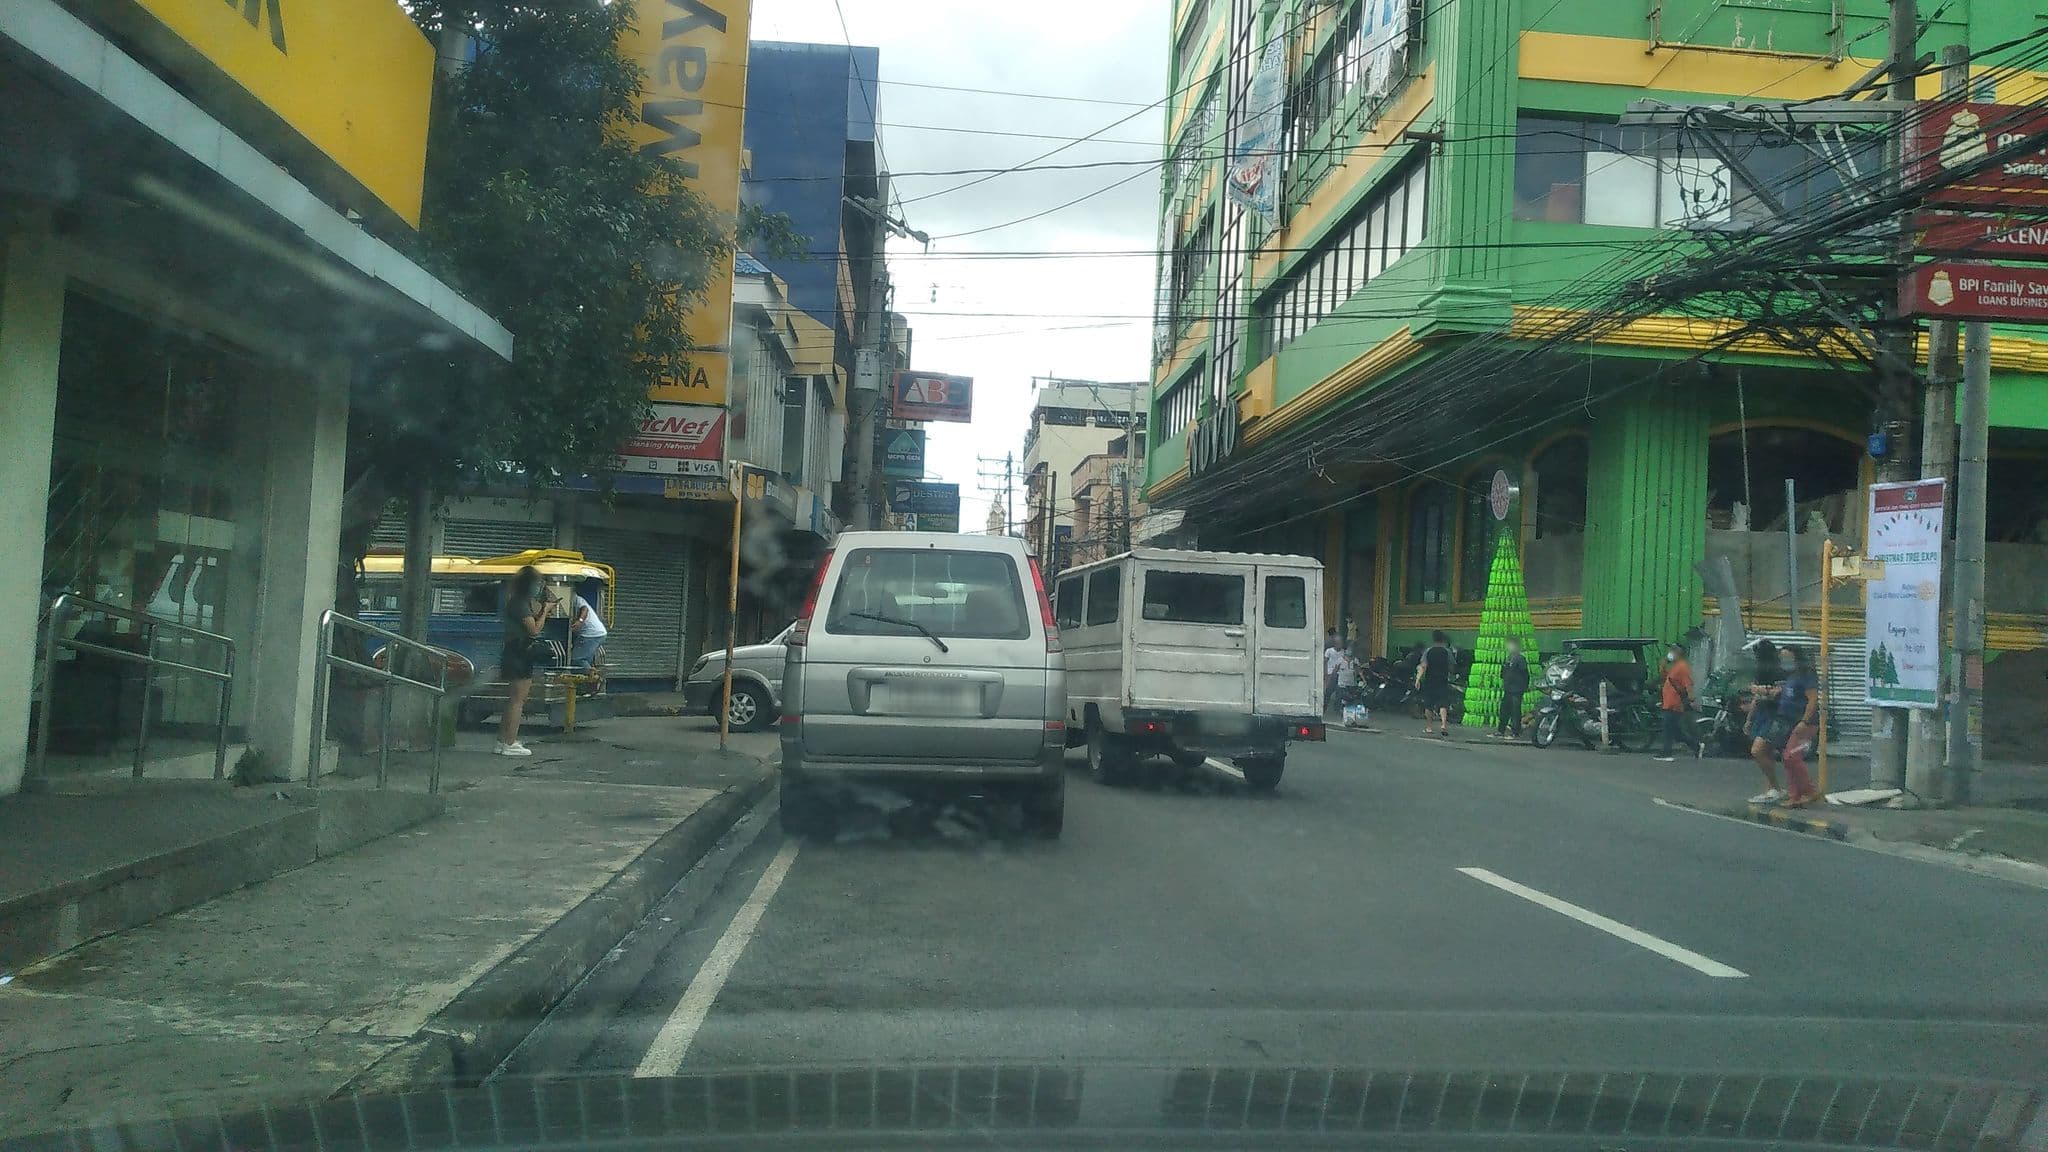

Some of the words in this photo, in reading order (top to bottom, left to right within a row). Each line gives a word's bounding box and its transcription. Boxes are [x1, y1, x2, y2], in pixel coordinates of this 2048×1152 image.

[1959, 278, 1979, 292] BPI
[1984, 279, 2024, 297] Family
[1978, 295, 2008, 306] LOANS
[654, 365, 710, 389] ENA
[693, 463, 716, 473] VISA
